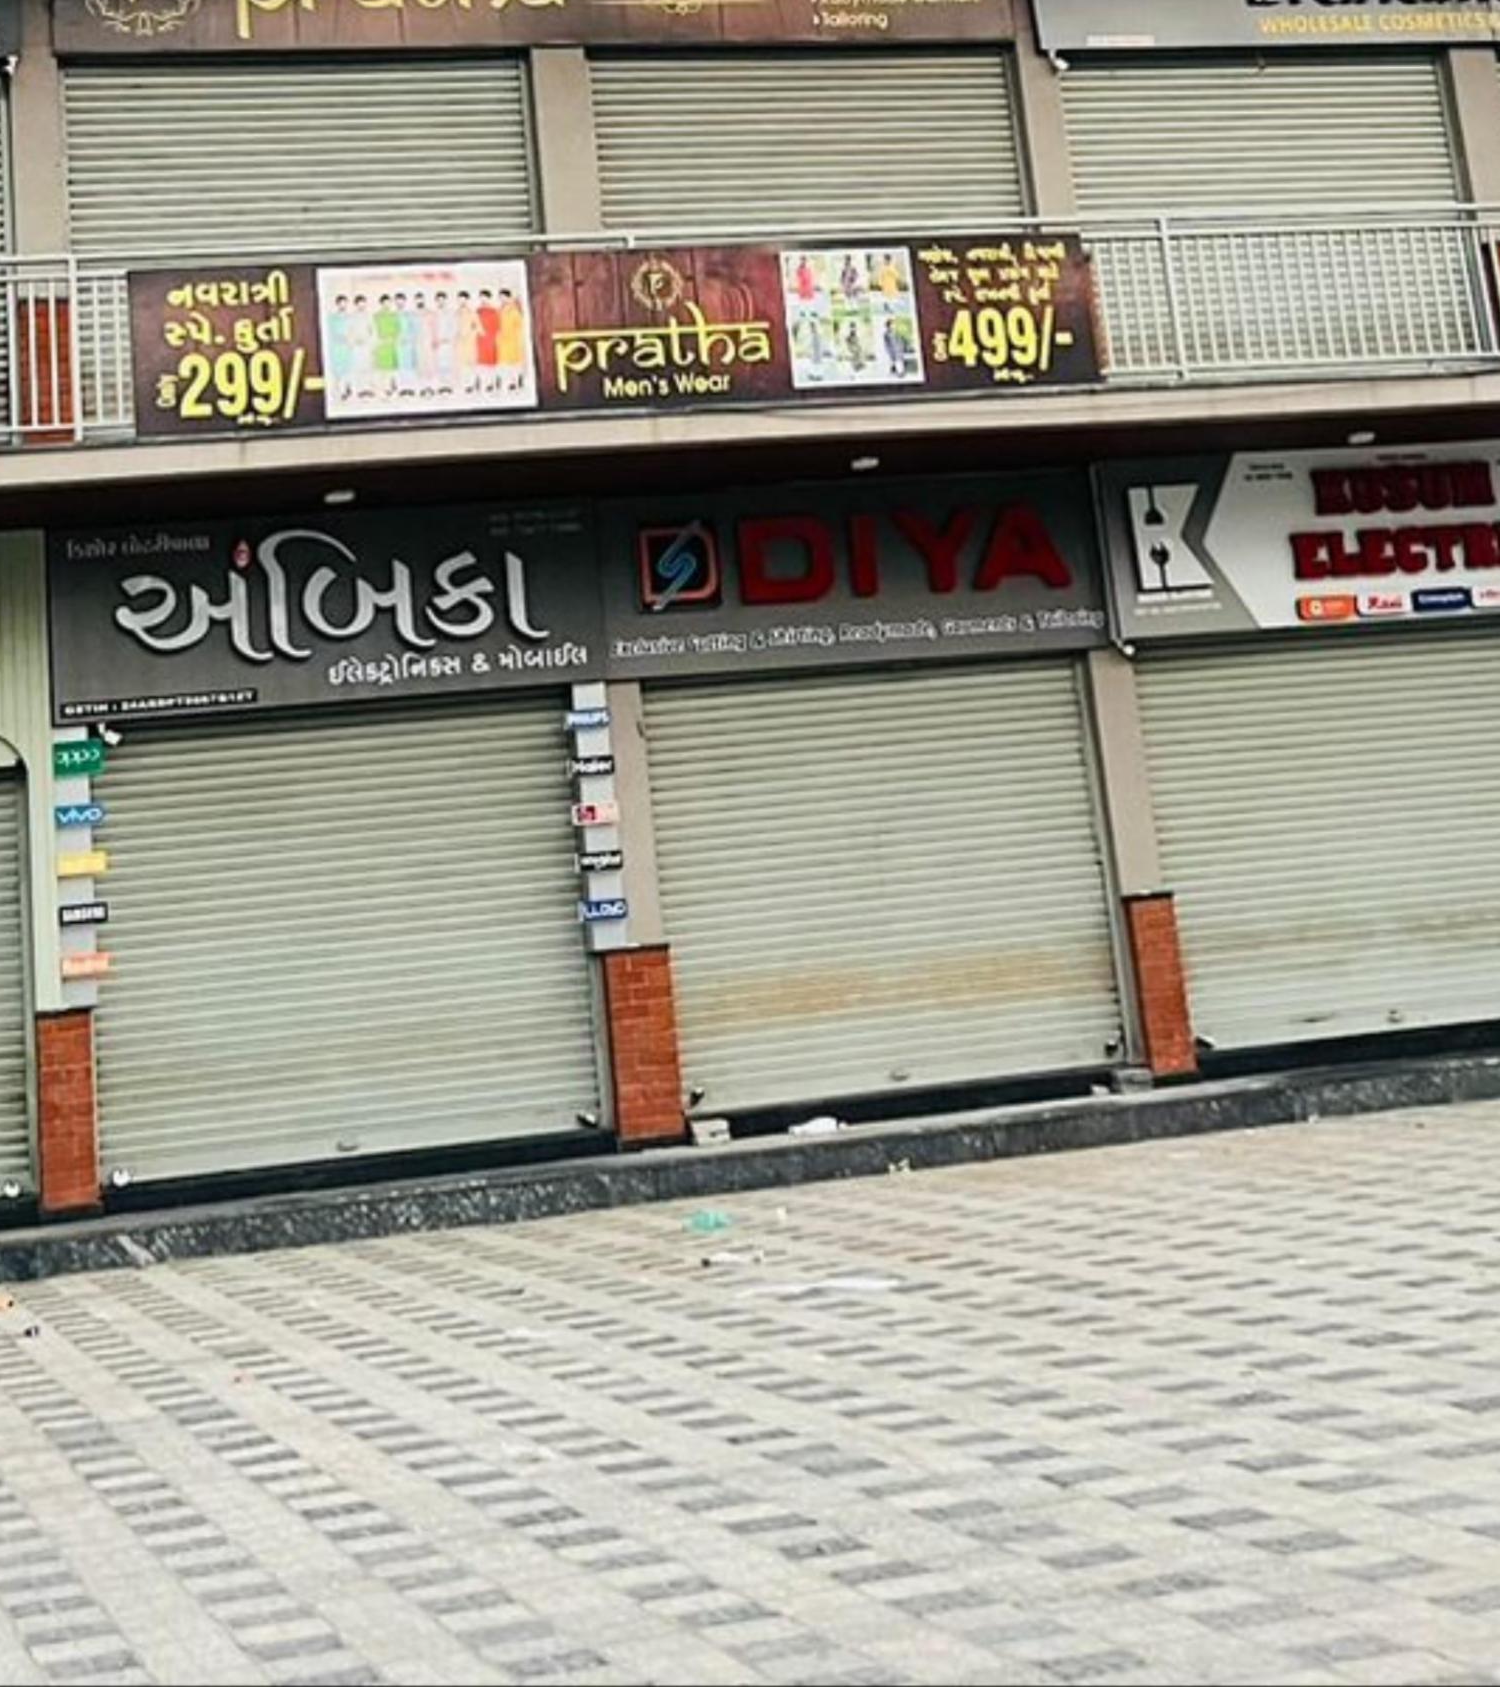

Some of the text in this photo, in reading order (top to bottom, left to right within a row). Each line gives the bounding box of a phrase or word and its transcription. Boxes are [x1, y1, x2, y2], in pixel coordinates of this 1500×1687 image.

[822, 11, 889, 30] Tailoring
[1258, 14, 1372, 34] WHOLESALE
[1379, 12, 1487, 32] COSMETICS
[553, 302, 771, 393] pratha
[948, 306, 1074, 371] 499/-
[178, 348, 325, 419] 299/-
[603, 373, 731, 399] Men's Wear
[738, 505, 1072, 605] DIYA
[472, 653, 491, 673] &
[498, 643, 588, 670] મોબાઈલ
[56, 807, 103, 824] vivo
